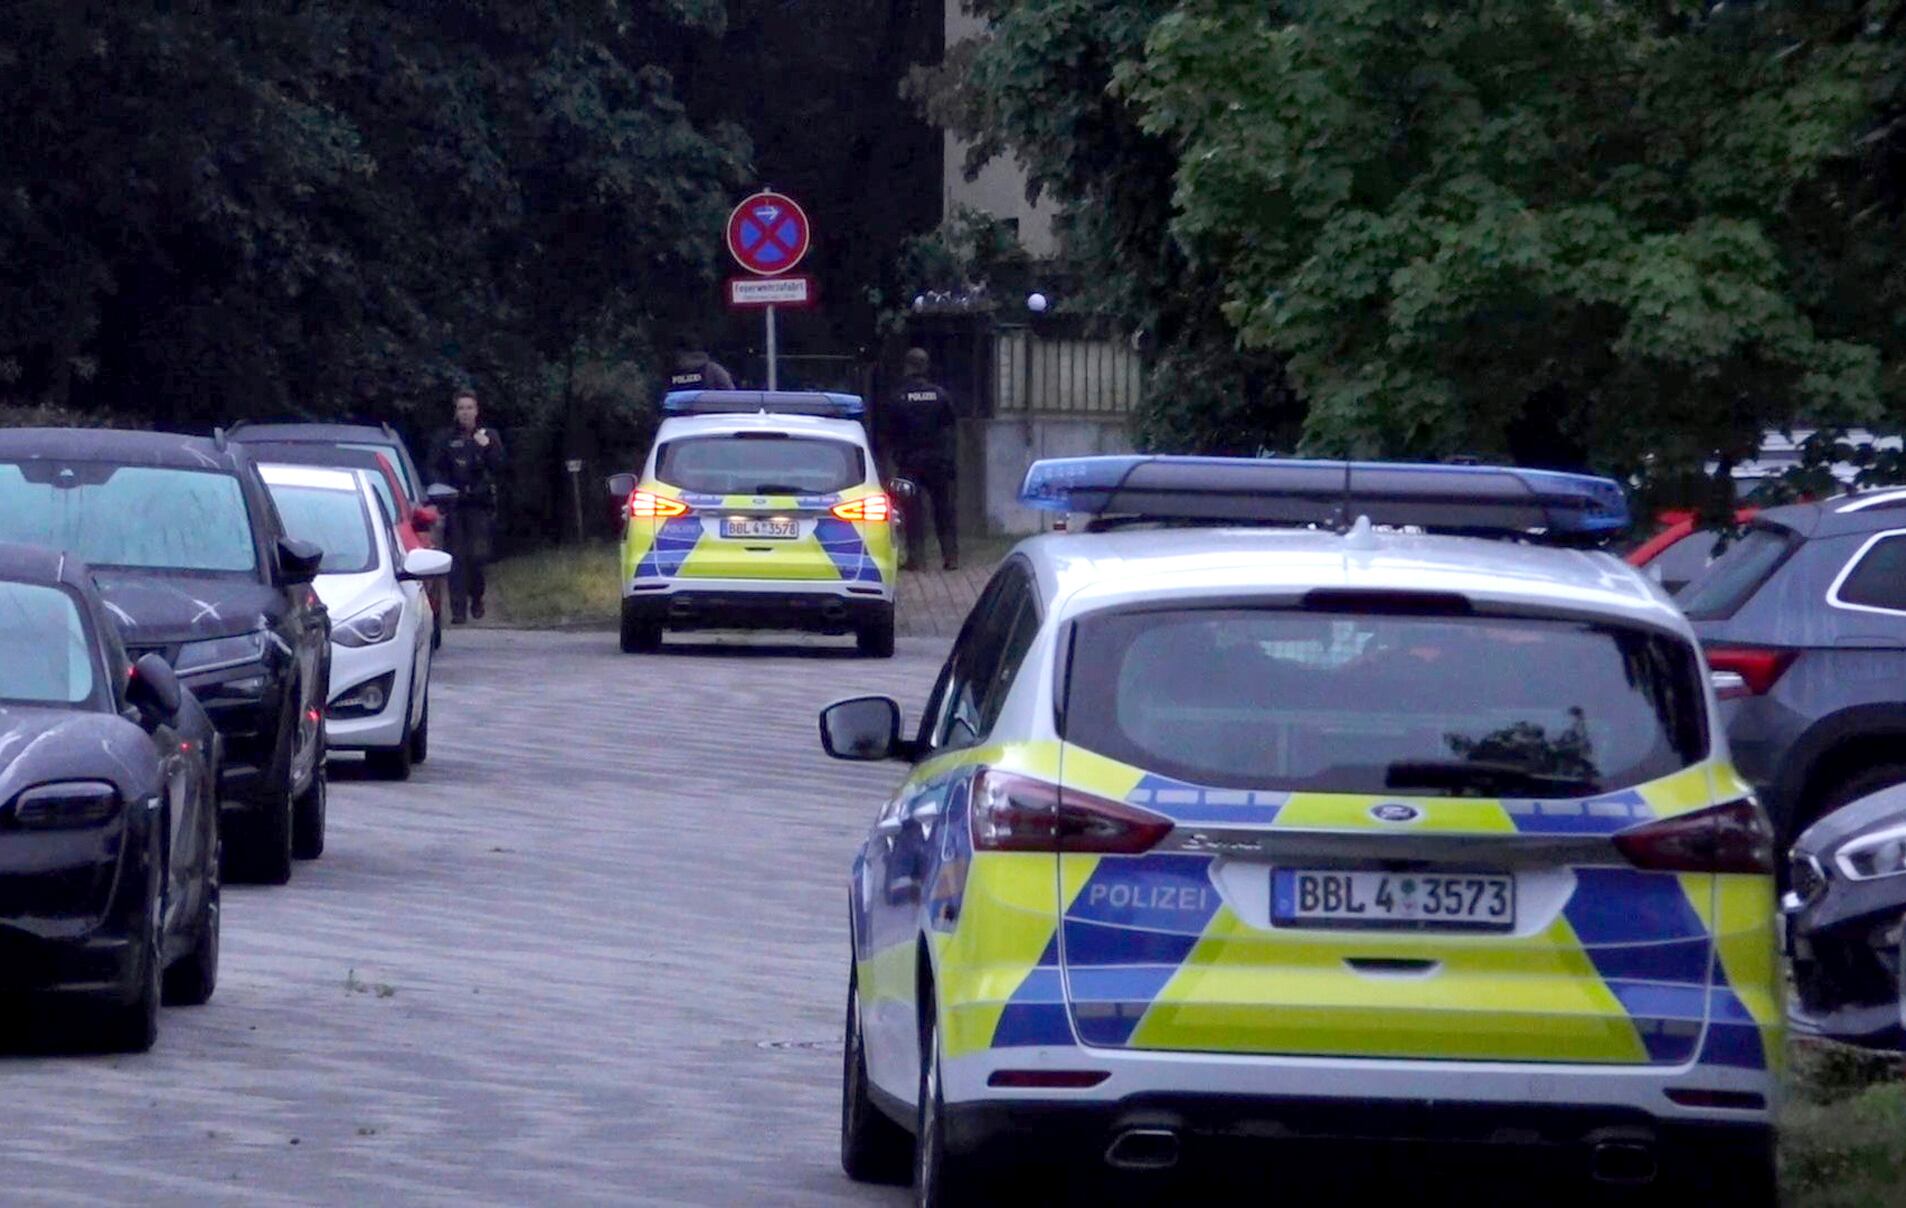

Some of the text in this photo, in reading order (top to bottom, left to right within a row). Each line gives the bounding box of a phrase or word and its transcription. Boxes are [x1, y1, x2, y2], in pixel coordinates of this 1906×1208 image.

[907, 391, 937, 401] POLIZEI
[729, 522, 750, 534] BBL
[768, 521, 796, 535] 3578
[1088, 883, 1207, 910] POLIZEI
[1299, 875, 1507, 916] BBL 4 3573
